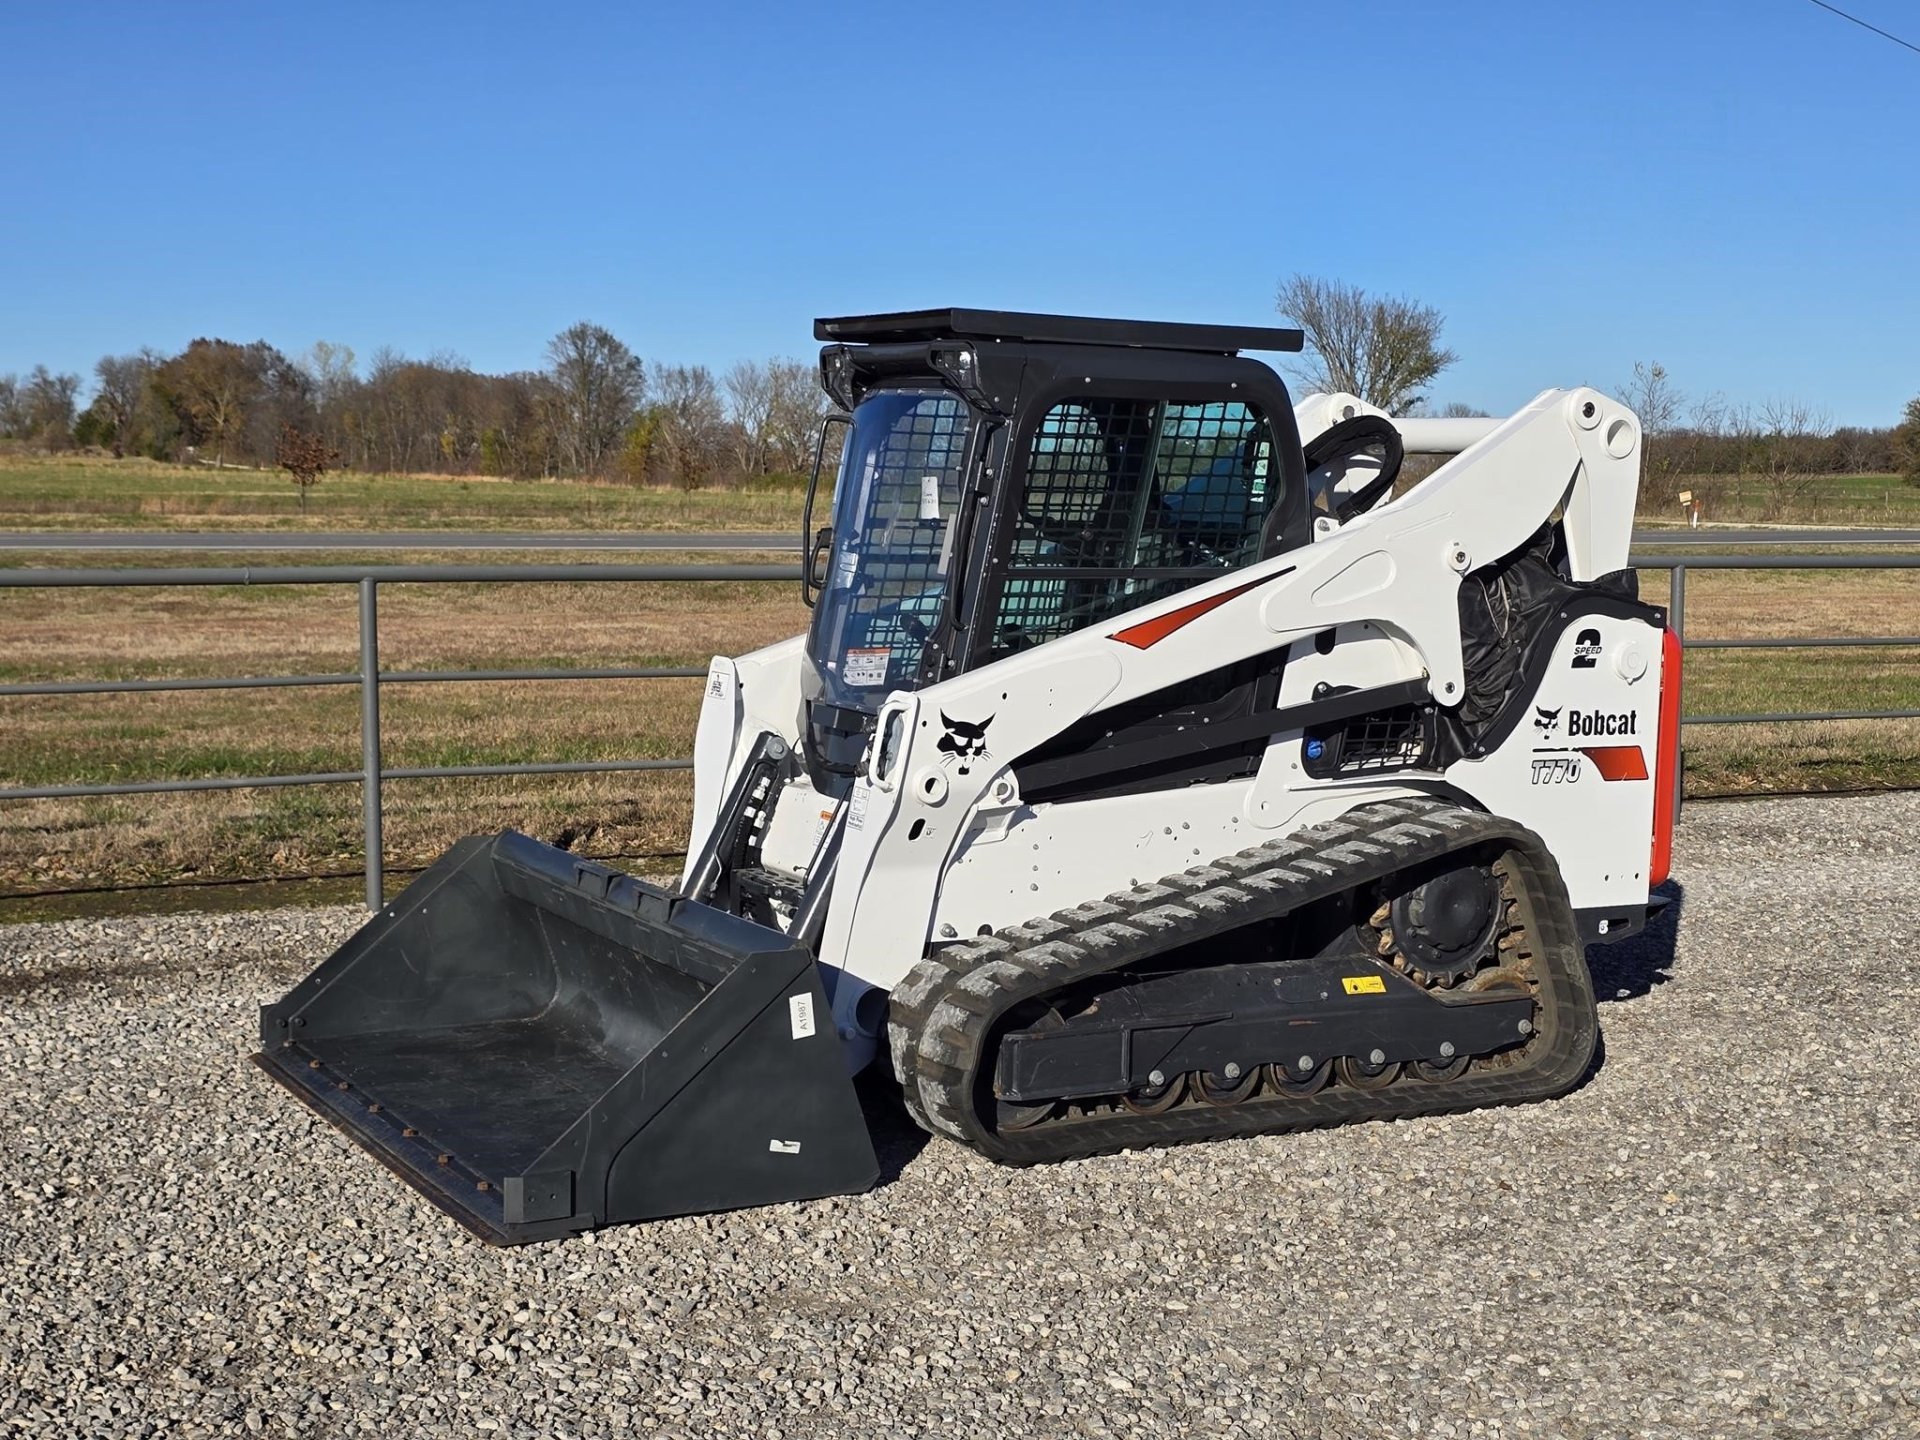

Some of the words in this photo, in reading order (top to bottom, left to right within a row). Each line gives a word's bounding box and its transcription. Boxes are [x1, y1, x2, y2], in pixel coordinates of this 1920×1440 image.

[1571, 629, 1601, 669] 2
[1574, 646, 1602, 655] SPEED
[1568, 709, 1637, 737] Bobcat
[1531, 758, 1582, 785] T770
[797, 1001, 808, 1031] A1987
